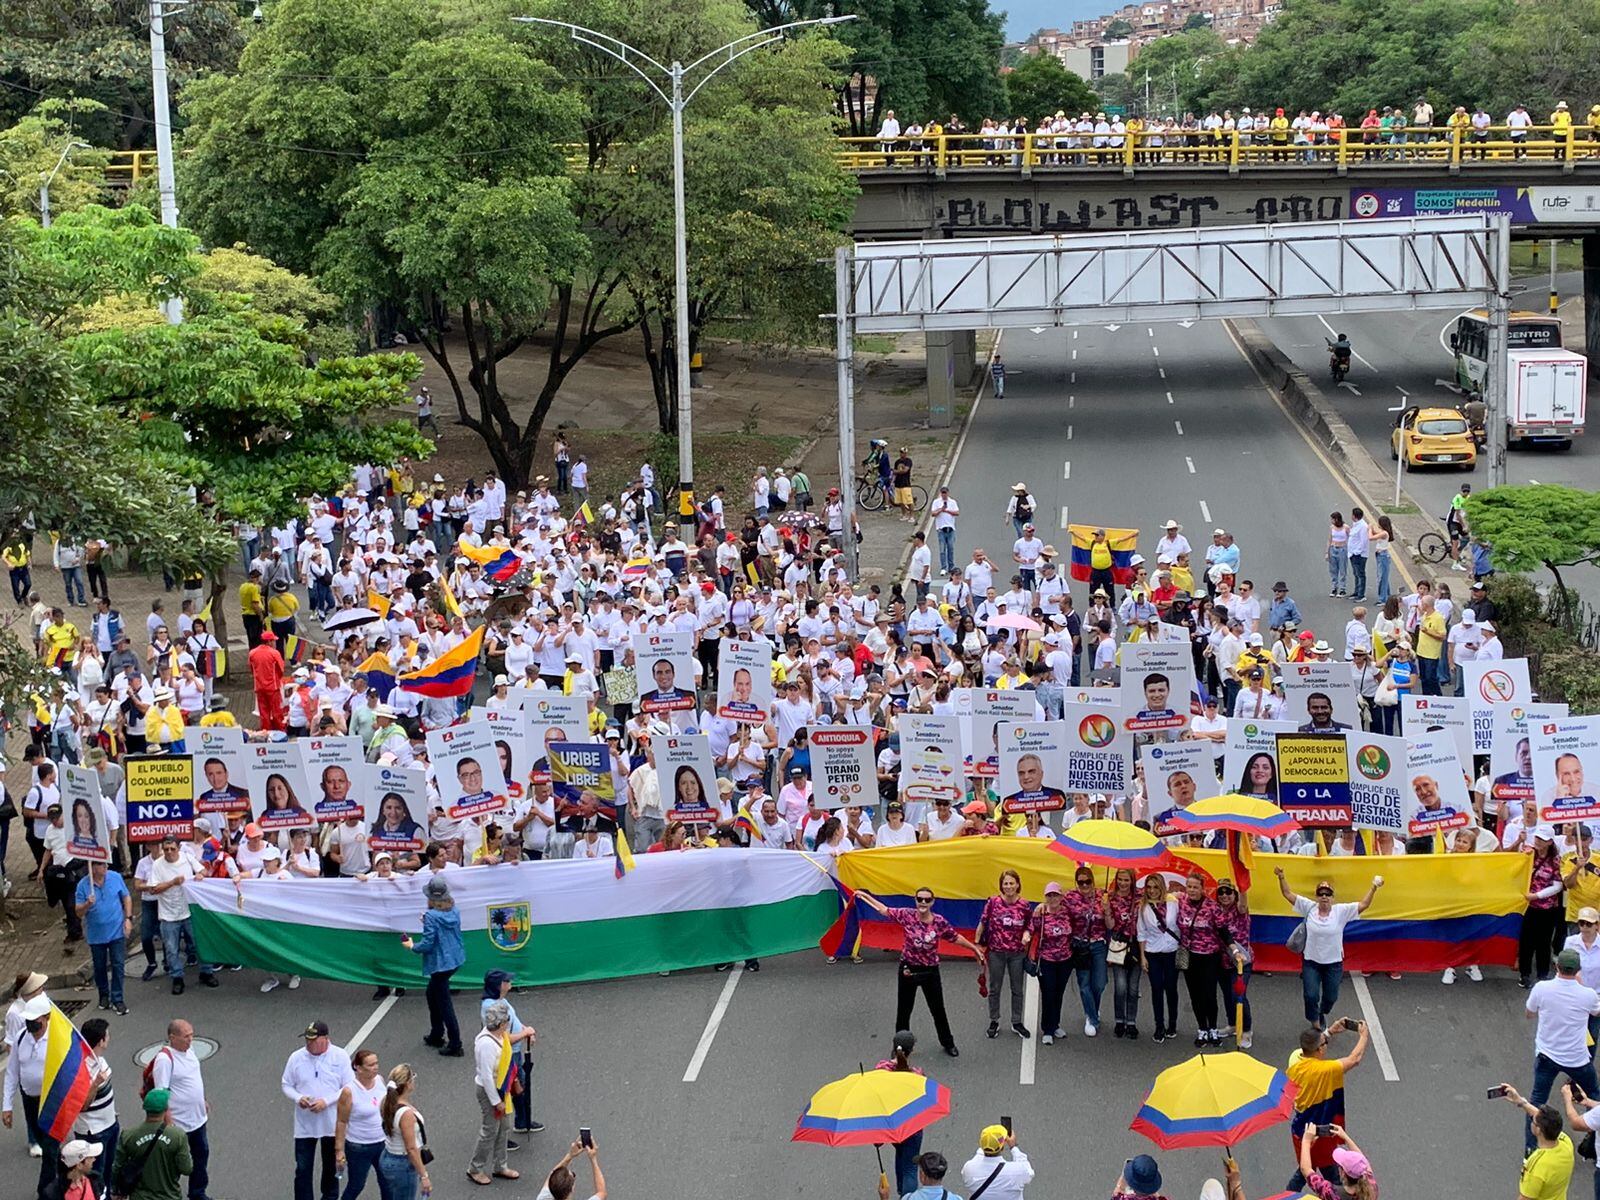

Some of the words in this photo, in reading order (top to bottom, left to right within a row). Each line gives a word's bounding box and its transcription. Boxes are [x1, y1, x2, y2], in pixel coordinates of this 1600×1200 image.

[1416, 198, 1454, 208] SOMOS
[1456, 197, 1500, 207] Medellín
[1507, 331, 1550, 339] CENTRO
[817, 734, 861, 743] ANTIOQUIA
[1552, 736, 1580, 744] Senador
[1069, 749, 1108, 760] CÓMPLICE
[1280, 746, 1345, 755] ¡CONGRESISTAS!
[560, 751, 601, 767] URIBE
[1288, 757, 1324, 766] ¿APOYAN
[1409, 753, 1433, 762] Senador
[138, 765, 148, 773] EL
[150, 763, 184, 773] PUEBLO
[824, 765, 860, 775] TIRANO
[1069, 759, 1104, 771] ROBO
[1108, 761, 1124, 772] DE
[1069, 771, 1124, 781] NUESTRAS
[1284, 768, 1338, 776] DEMOCRACIA
[130, 776, 190, 786] COLOMBIANO
[566, 773, 600, 786] LIBRE
[828, 774, 859, 784] PETRO
[1068, 780, 1125, 791] PENSIONES
[1350, 780, 1384, 794] ÓMPLICE
[1385, 787, 1401, 796] DEL
[145, 788, 172, 797] DICE
[1297, 788, 1307, 798] O
[1314, 788, 1332, 798] LA
[1384, 795, 1401, 809] DE
[138, 804, 168, 819] NO
[1352, 802, 1401, 819] UESTRAS
[1352, 812, 1402, 829] ENSIONES
